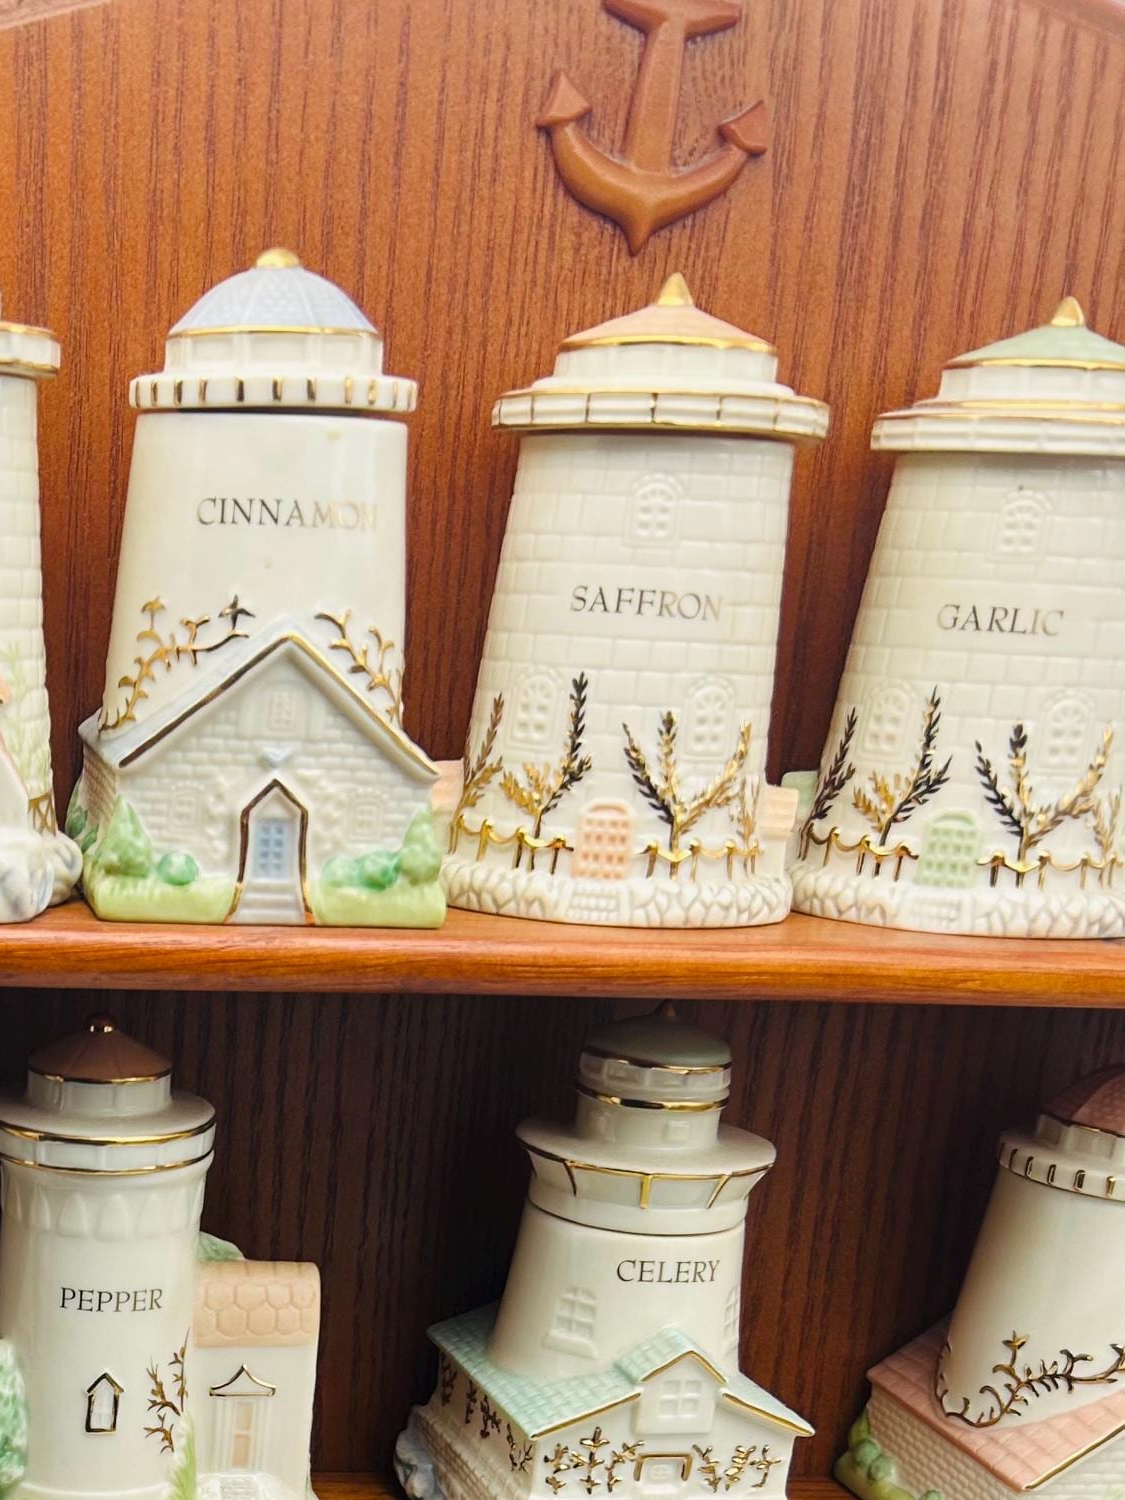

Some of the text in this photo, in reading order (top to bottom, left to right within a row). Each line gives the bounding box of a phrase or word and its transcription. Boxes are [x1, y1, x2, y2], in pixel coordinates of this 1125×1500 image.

[196, 496, 378, 530] CINNAMON
[570, 585, 723, 622] SAFFRON
[937, 603, 1065, 636] GARLIC
[616, 1259, 721, 1283] CELERY
[60, 1287, 163, 1312] PEPPER
